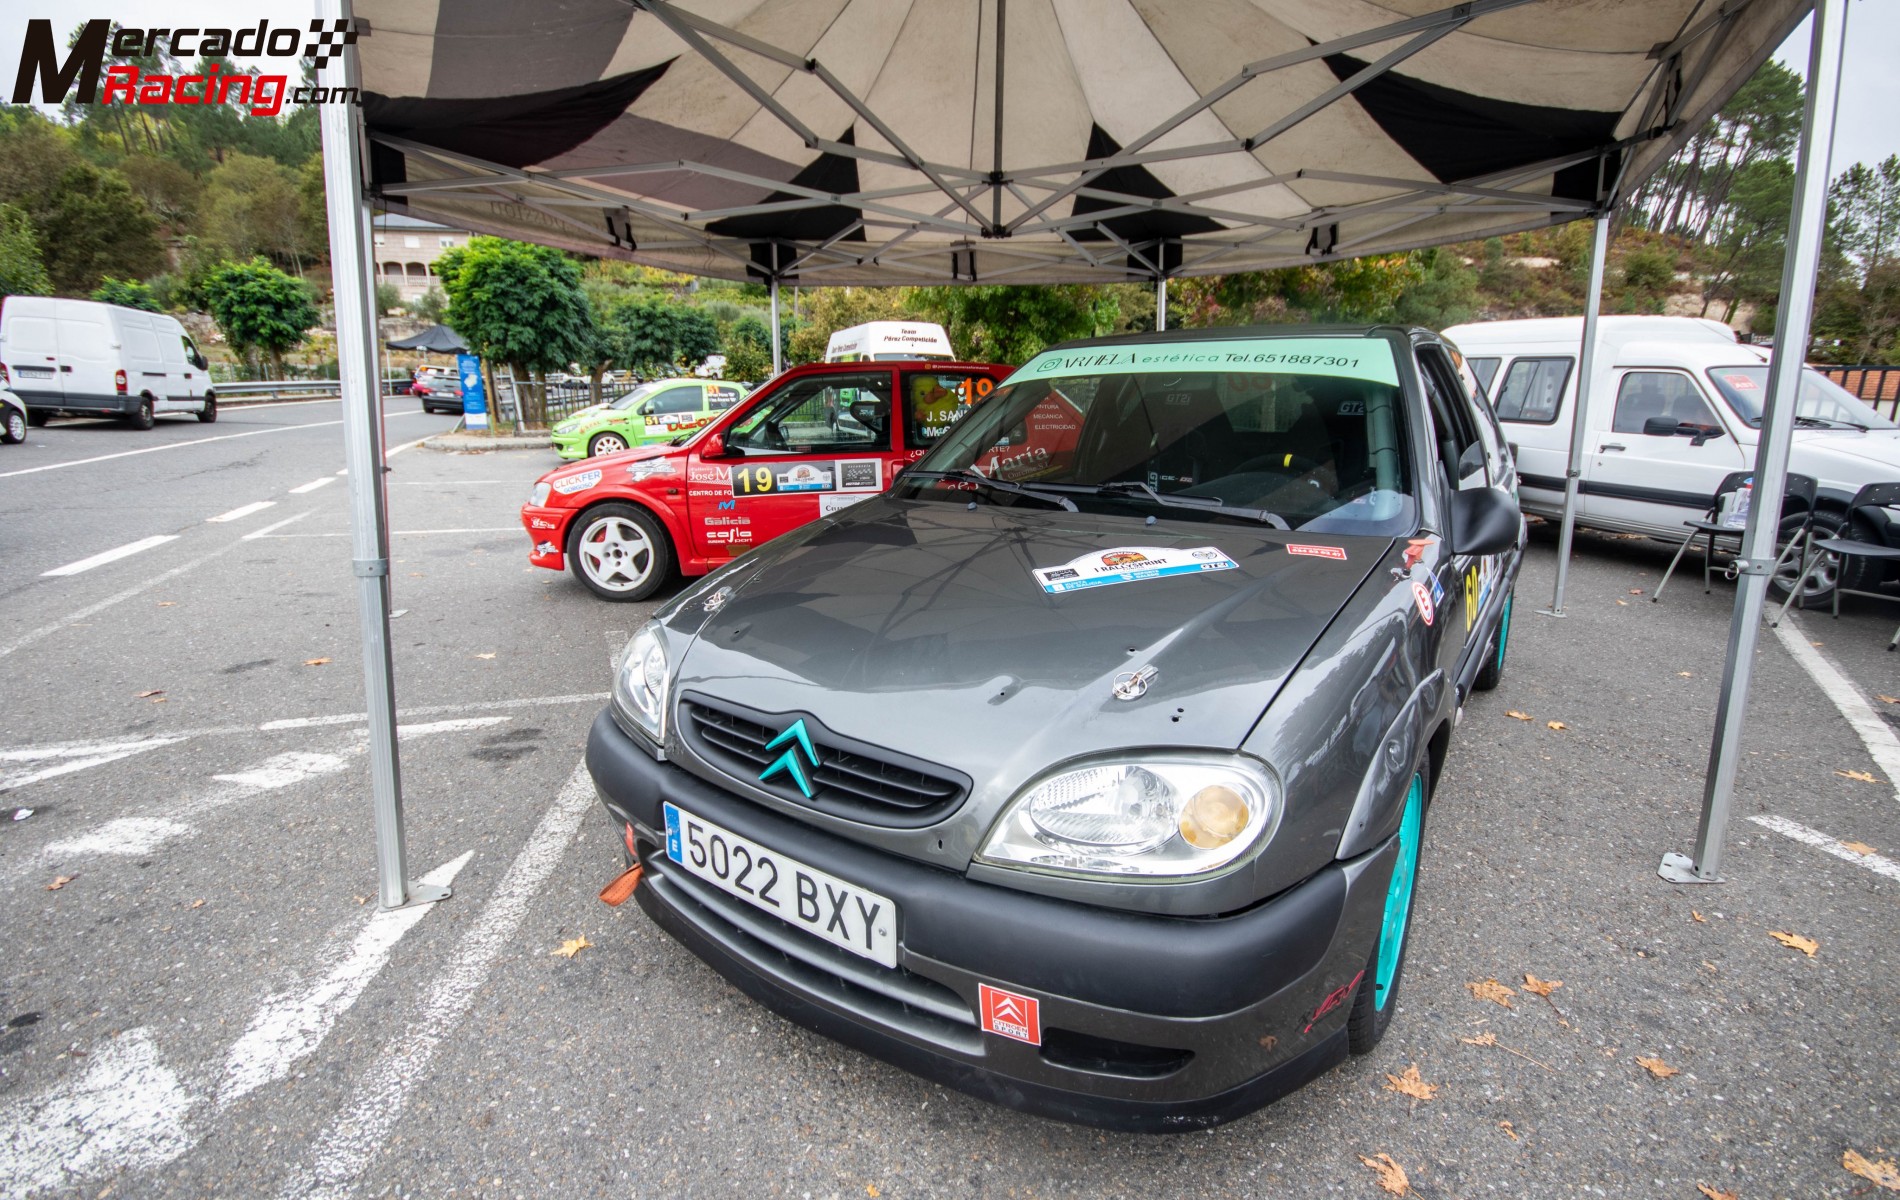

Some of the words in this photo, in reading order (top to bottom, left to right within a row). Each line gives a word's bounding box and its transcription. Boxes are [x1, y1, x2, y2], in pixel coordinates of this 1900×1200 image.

[1142, 353, 1219, 363] estética
[960, 377, 994, 406] 19
[1338, 401, 1365, 414] GT2
[645, 416, 660, 426] 51
[939, 410, 968, 422] SAN
[554, 470, 601, 488] CLICKFER
[689, 470, 715, 482] José
[737, 467, 773, 493] 19
[704, 516, 751, 526] Galicia
[1099, 558, 1168, 573] RALLYSPRINT
[671, 838, 679, 853] E
[687, 820, 780, 908] 5022
[796, 871, 881, 951] BXY
[994, 1024, 1028, 1039] SPORT
